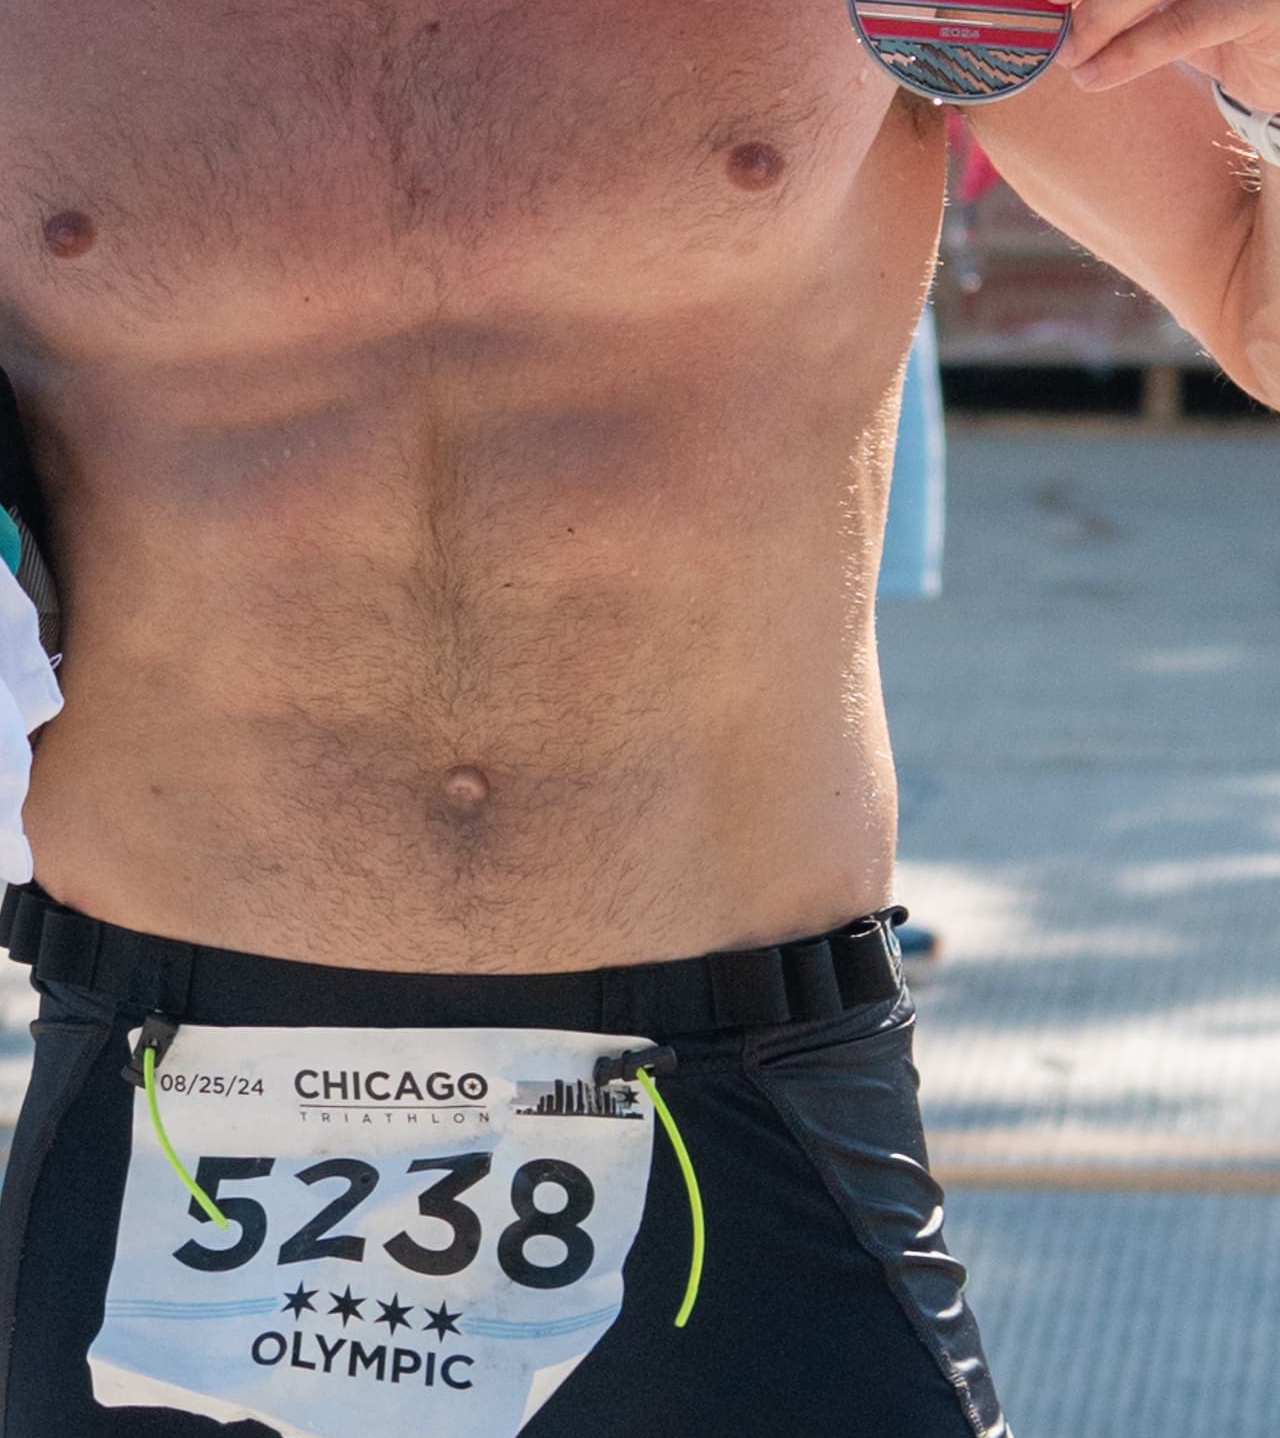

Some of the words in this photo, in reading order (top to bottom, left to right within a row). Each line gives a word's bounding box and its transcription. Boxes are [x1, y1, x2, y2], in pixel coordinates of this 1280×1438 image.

[160, 1073, 264, 1096] 08/25/24
[294, 1069, 488, 1101] CHICAGO
[299, 1112, 490, 1124] TRIATHLON
[172, 1151, 595, 1290] 5238
[251, 1331, 475, 1390] OLYMPIC
